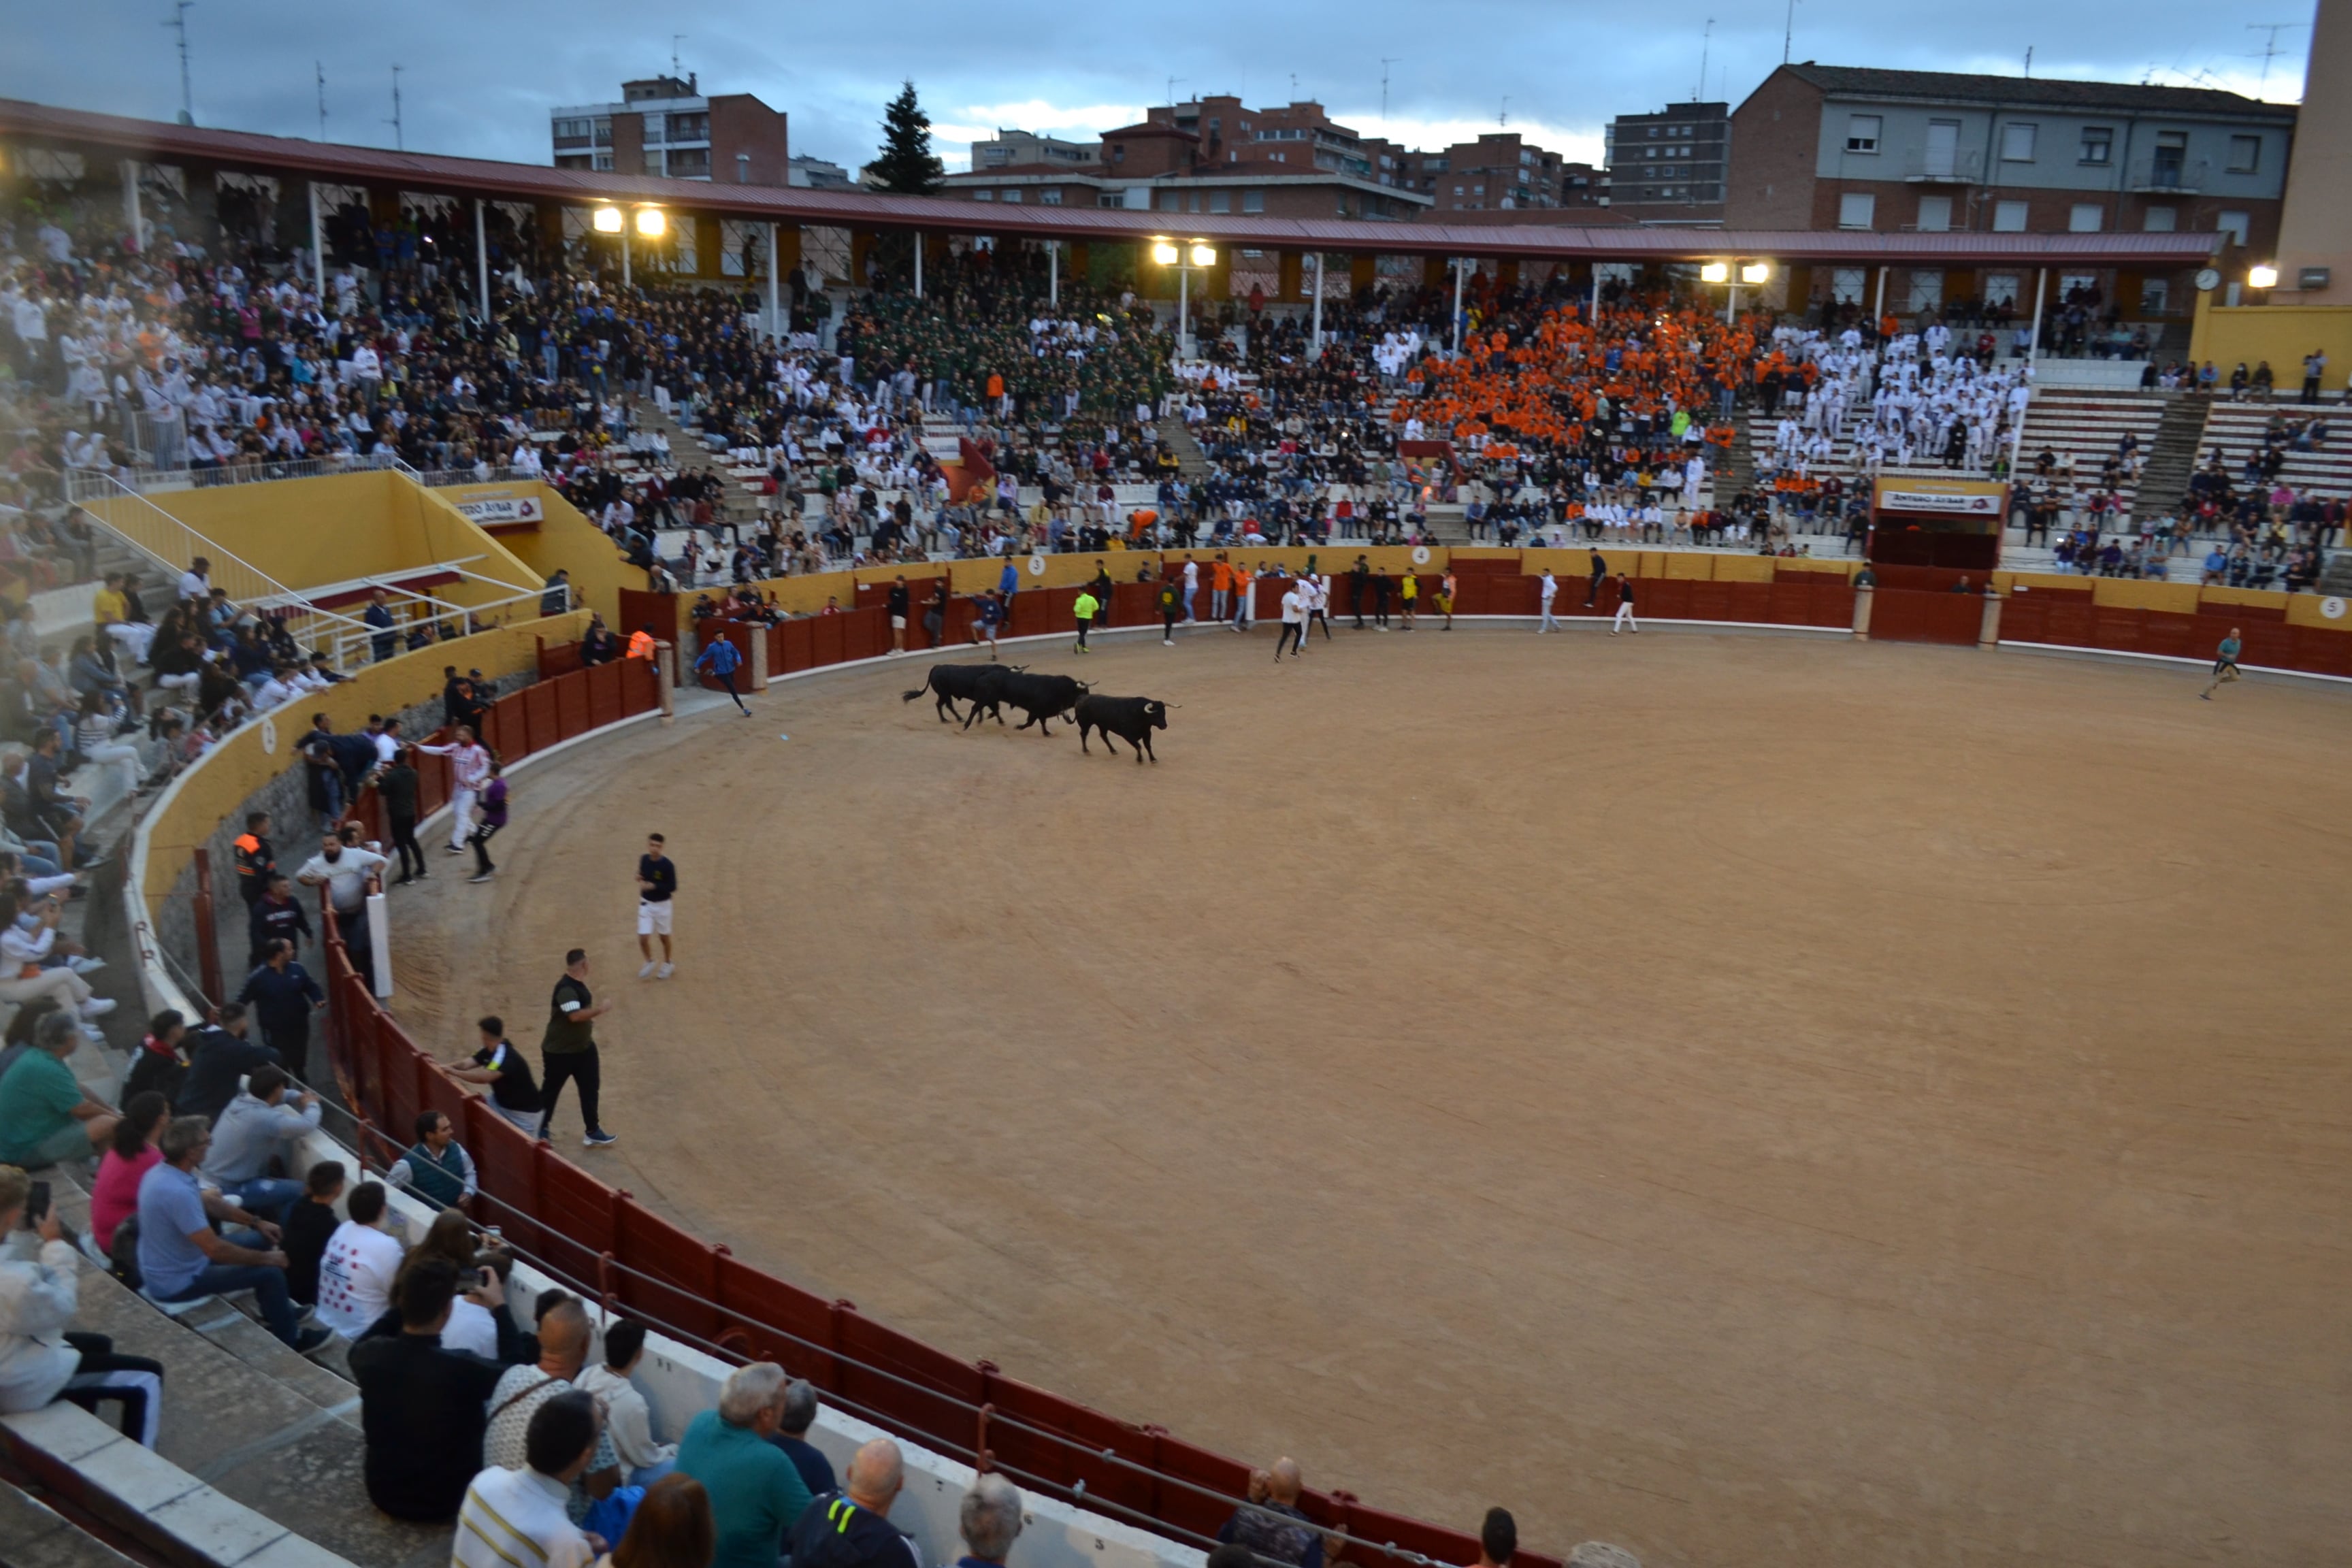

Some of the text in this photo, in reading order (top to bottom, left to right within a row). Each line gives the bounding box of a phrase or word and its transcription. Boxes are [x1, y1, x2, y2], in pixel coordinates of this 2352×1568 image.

[1417, 550, 1424, 559] 4
[1033, 559, 1041, 570] 3
[2328, 602, 2337, 612] 5
[560, 1000, 581, 1012] PUMA
